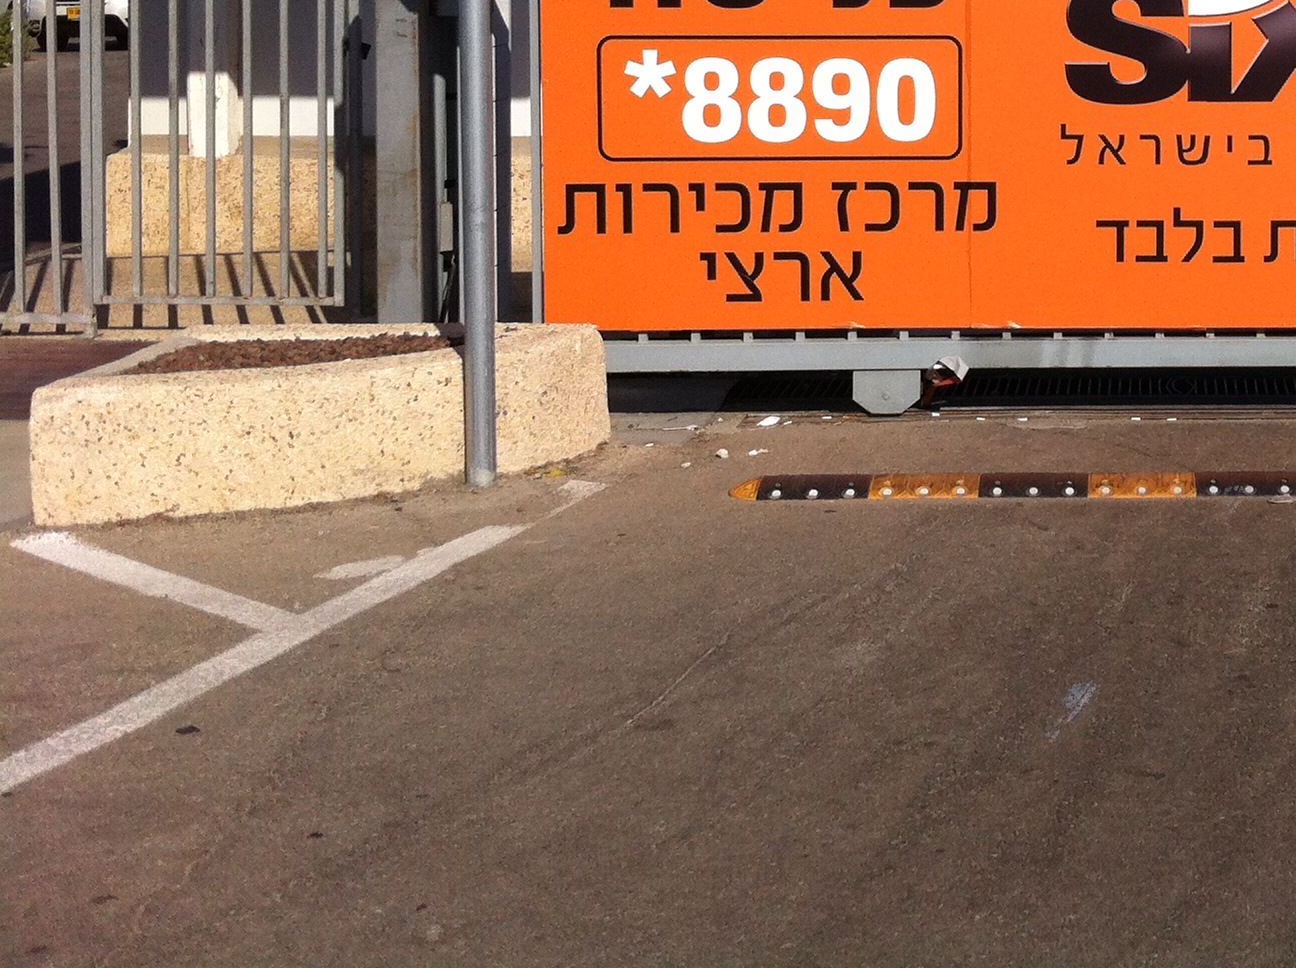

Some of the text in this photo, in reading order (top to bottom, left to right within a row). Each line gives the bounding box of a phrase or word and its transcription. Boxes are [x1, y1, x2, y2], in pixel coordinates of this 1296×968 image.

[1061, 124, 1272, 165] בישראל
[558, 182, 996, 234] מרכז מכירות
[1096, 207, 1245, 263] בלבד
[700, 251, 864, 302] ארצי
